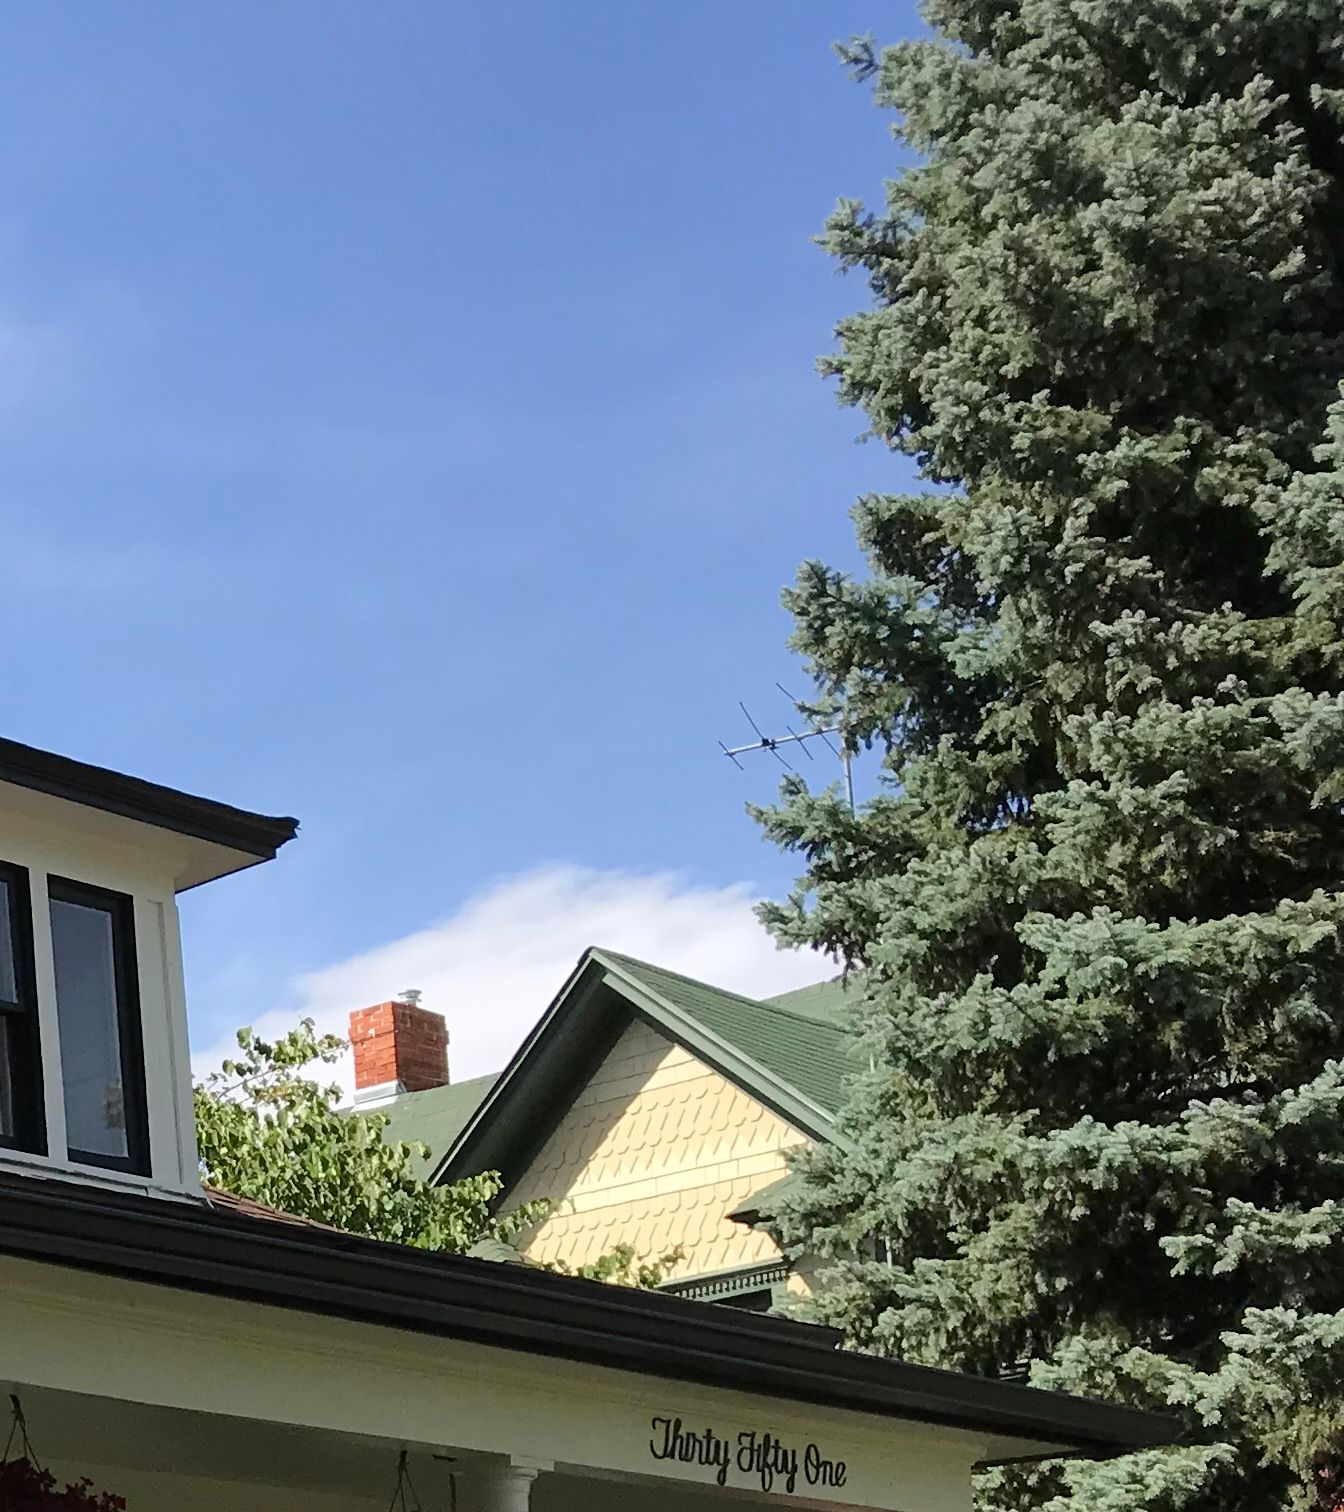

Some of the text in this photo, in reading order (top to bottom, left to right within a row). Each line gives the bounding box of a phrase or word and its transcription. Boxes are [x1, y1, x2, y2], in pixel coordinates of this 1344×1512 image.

[650, 1417, 847, 1493] Thirty Fifty One
